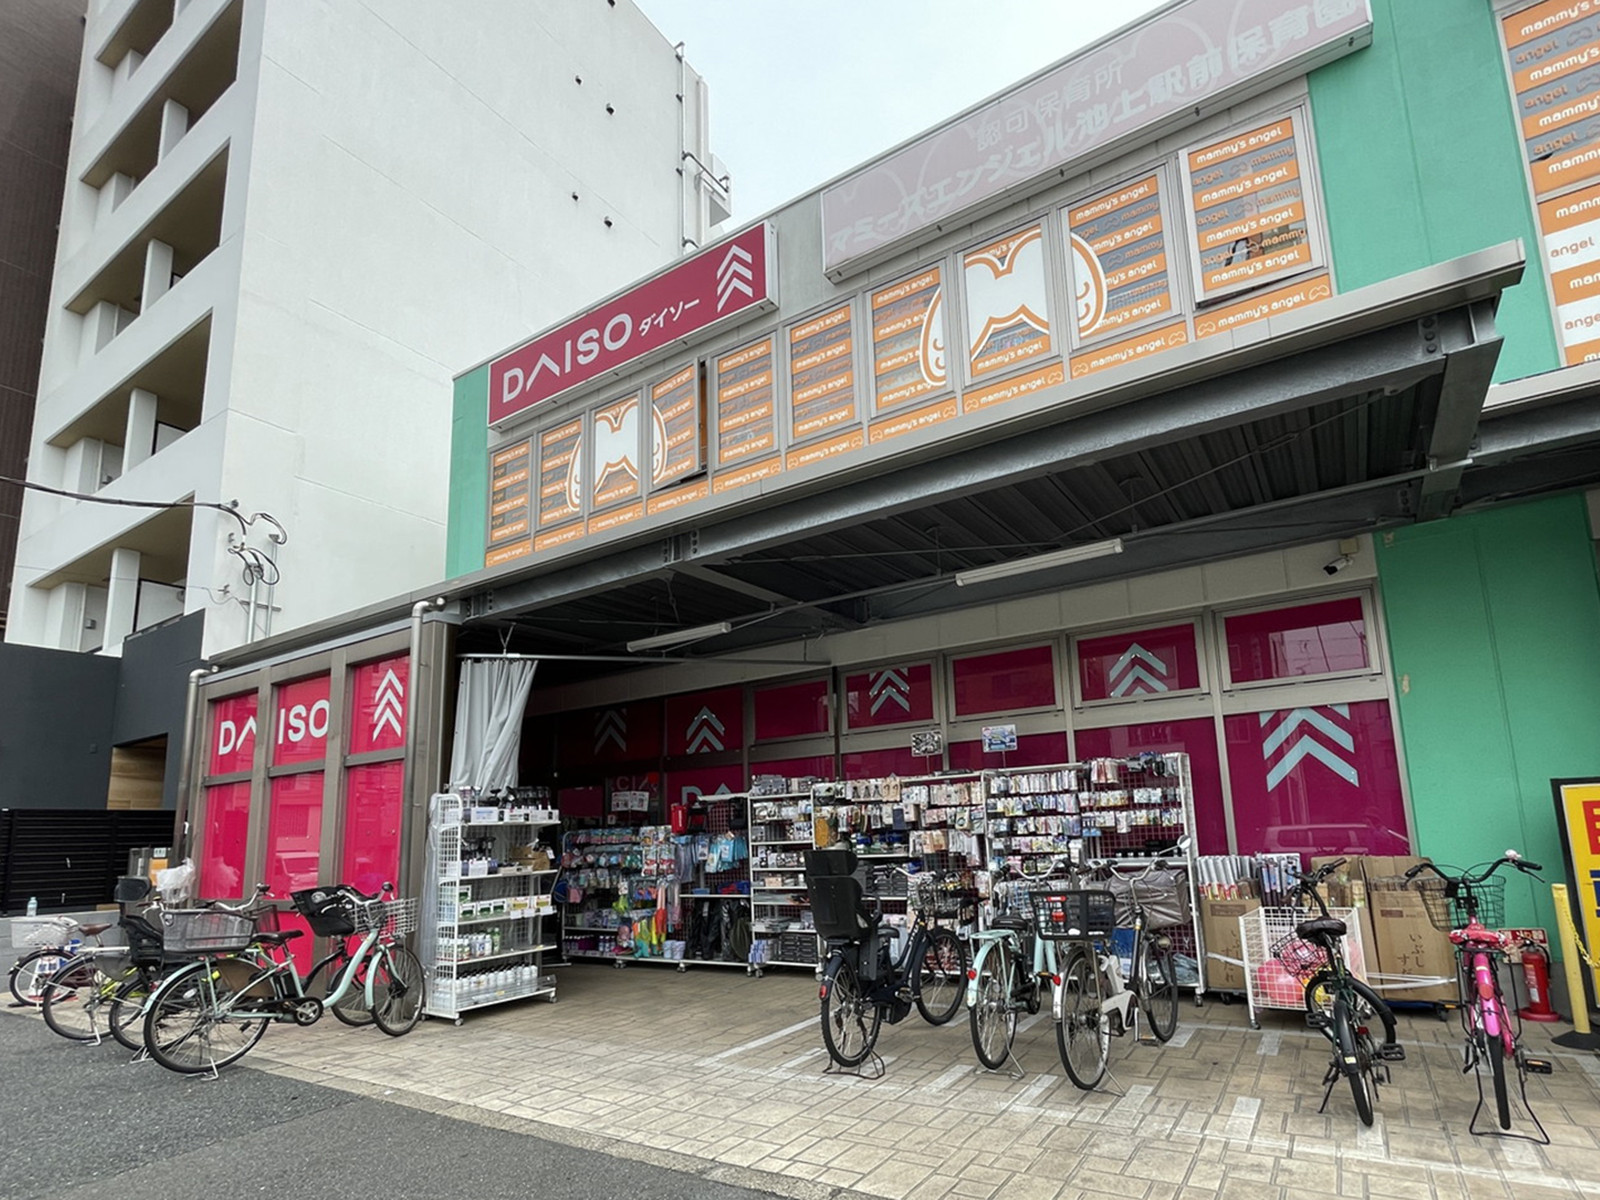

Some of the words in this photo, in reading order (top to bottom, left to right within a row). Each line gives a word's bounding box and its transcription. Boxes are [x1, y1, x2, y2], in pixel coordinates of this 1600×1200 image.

[1521, 1, 1589, 35] mammy's
[1515, 39, 1559, 64] angel
[1530, 47, 1600, 80] mammy's
[1524, 84, 1567, 109] angel
[1197, 141, 1246, 164] mammy's
[1249, 127, 1283, 146] angel
[1534, 131, 1577, 155] angel
[1193, 169, 1223, 186] angel
[1201, 179, 1251, 204] mammy's
[1254, 167, 1288, 186] angel
[1075, 197, 1118, 220] mammy's
[1120, 184, 1148, 201] angel
[1092, 235, 1121, 251] mmy's
[1124, 222, 1153, 239] angel
[1206, 220, 1257, 243] mammy's
[1260, 208, 1294, 226] angel
[1551, 236, 1594, 258] angel
[1128, 261, 1157, 277] angel
[1211, 260, 1263, 283] mammy's
[1265, 250, 1300, 268] angel
[639, 299, 700, 336] ダイソー
[1099, 309, 1129, 326] mmy's
[1132, 300, 1161, 316] angel
[1218, 304, 1269, 327] mammy's
[1271, 293, 1305, 310] angel
[502, 314, 633, 403] DAISO
[1017, 341, 1043, 356] angel
[1090, 346, 1134, 368] mammy's
[1136, 337, 1165, 354] angel
[1020, 378, 1045, 392] angel
